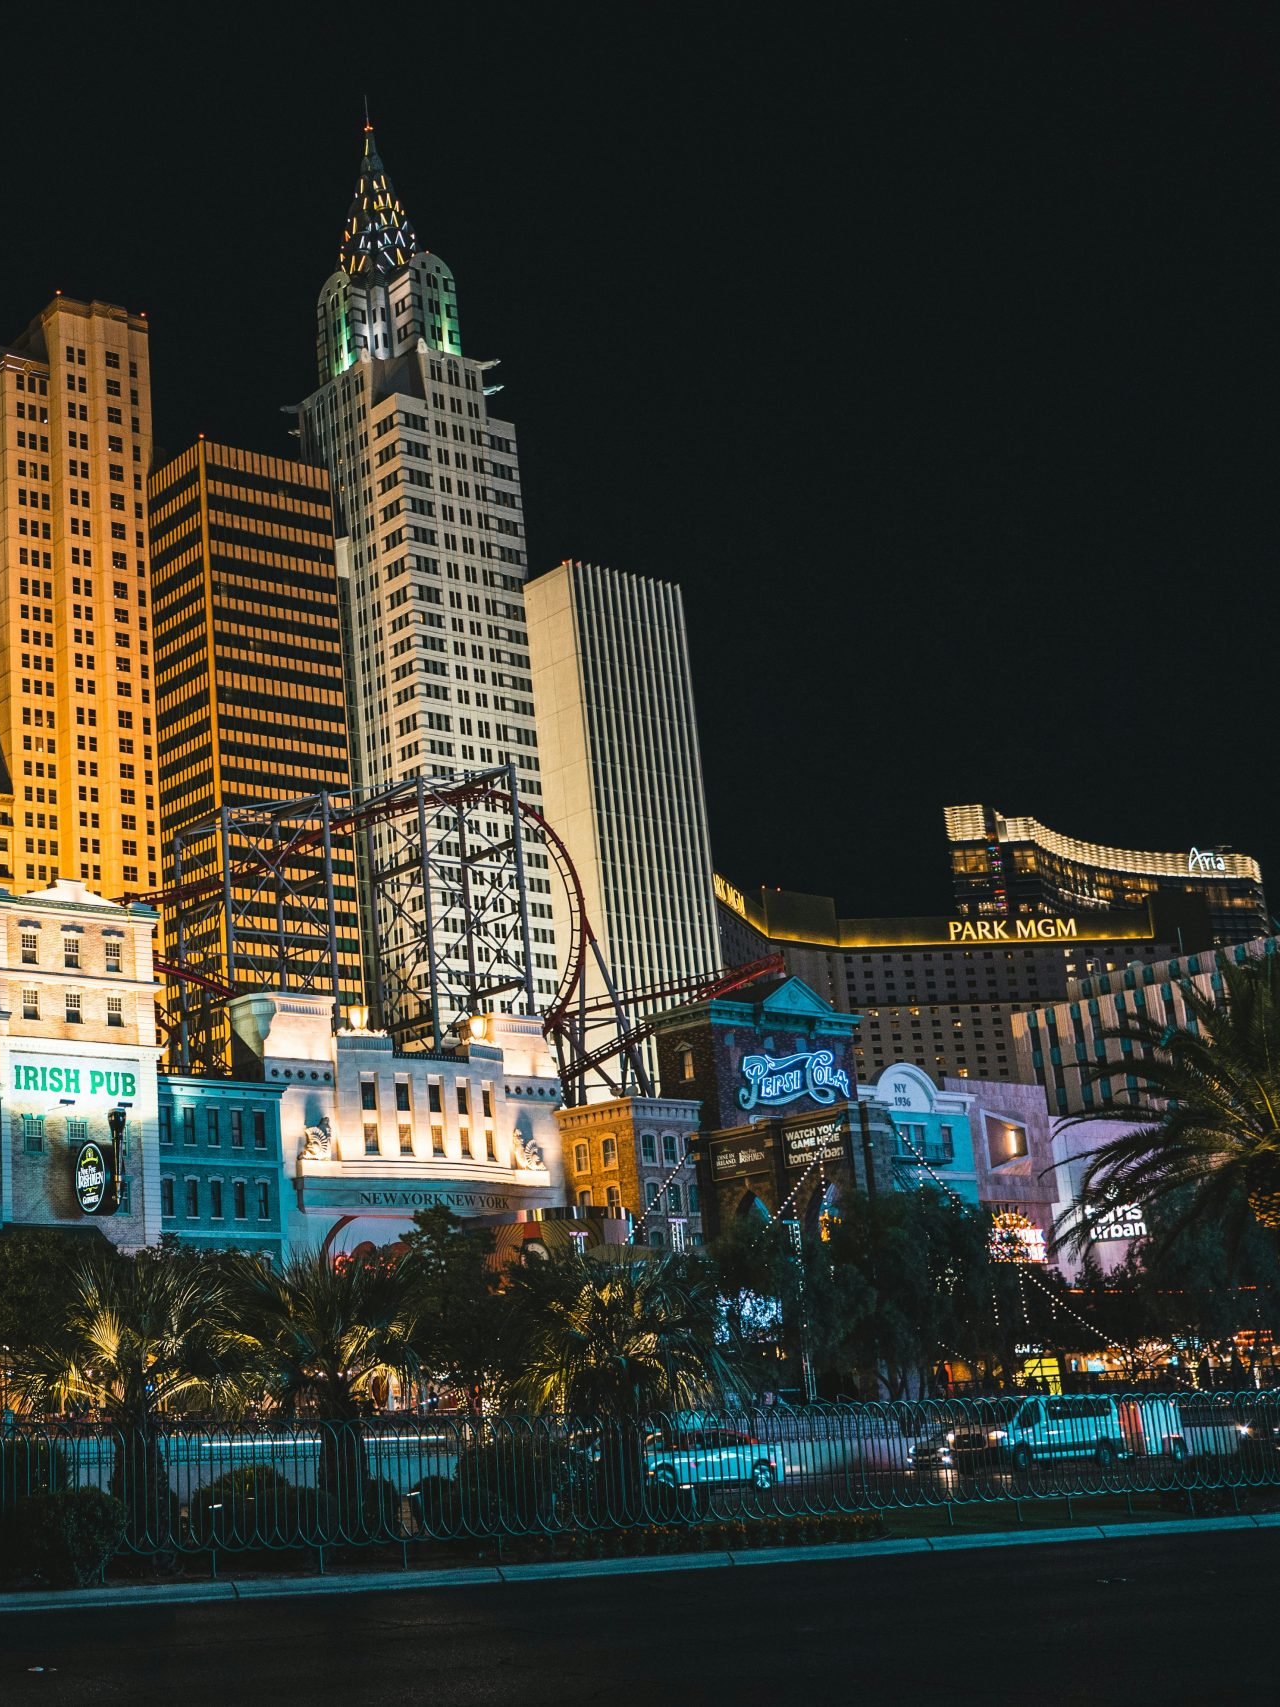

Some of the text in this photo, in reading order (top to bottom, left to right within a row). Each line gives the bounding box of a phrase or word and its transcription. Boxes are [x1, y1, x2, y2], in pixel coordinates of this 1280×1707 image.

[949, 918, 1077, 940] PARK MGM
[14, 1065, 136, 1097] IRISH PUB
[894, 1083, 906, 1093] NY
[894, 1097, 911, 1107] 1936
[786, 1128, 816, 1141] WATCH
[791, 1137, 816, 1149] GAME
[360, 1192, 510, 1209] NEW YORK NEW YORK
[1090, 1221, 1147, 1240] urban
